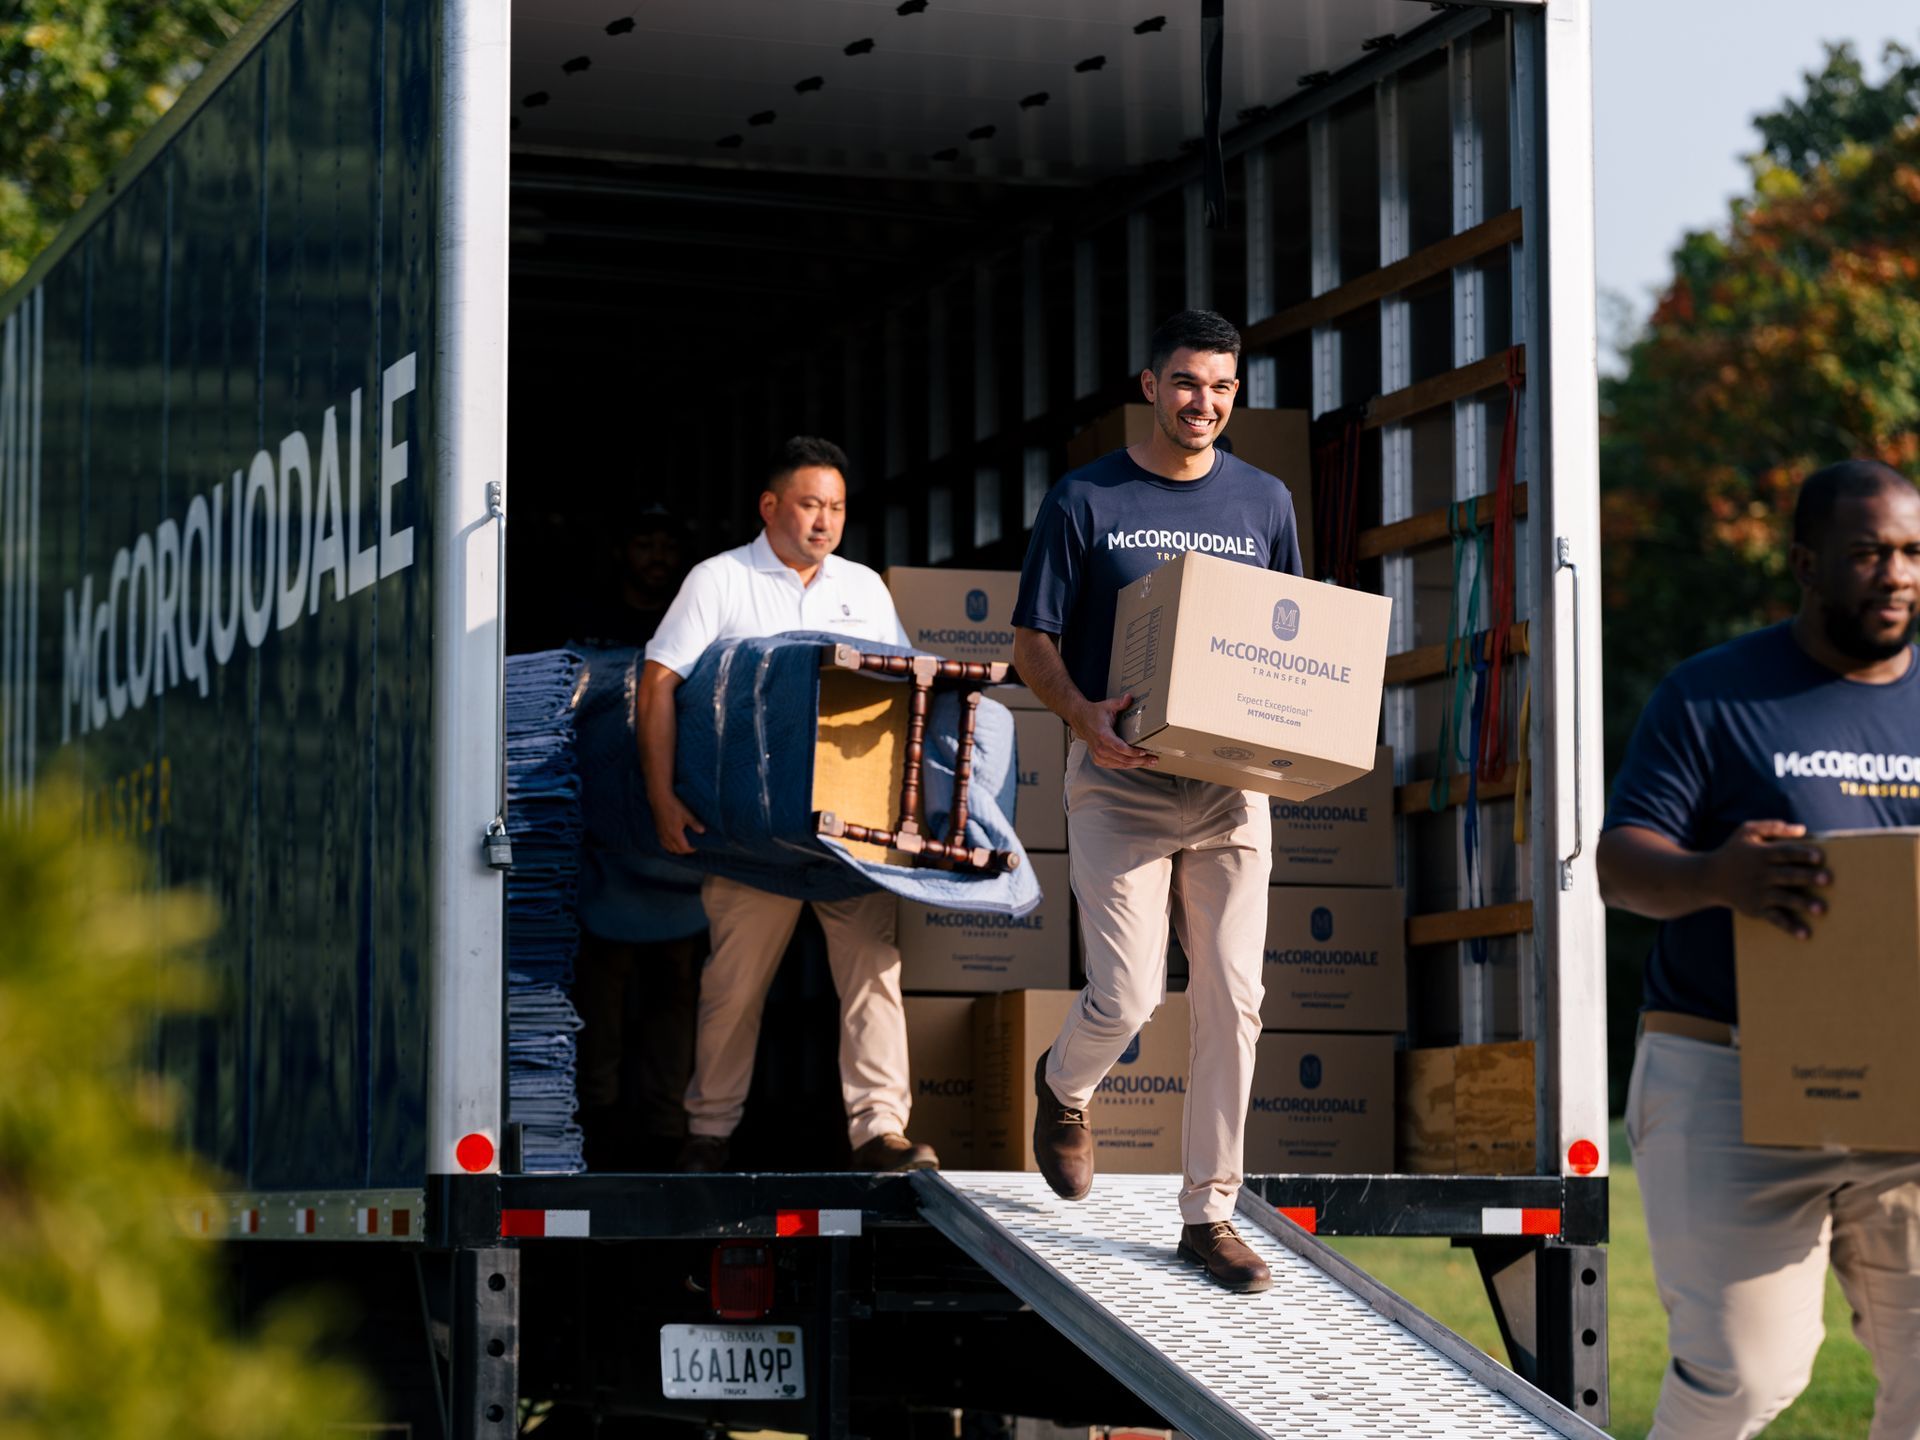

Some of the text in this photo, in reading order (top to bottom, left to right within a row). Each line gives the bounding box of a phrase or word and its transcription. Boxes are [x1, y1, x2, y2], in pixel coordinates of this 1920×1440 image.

[62, 352, 417, 744] McCORQUODALE
[1107, 529, 1256, 556] McCORQUODALE
[1156, 552, 1180, 561] TRA
[1210, 636, 1352, 684] McCORQUODALE
[1252, 667, 1307, 686] TRANSFER
[1237, 693, 1264, 706] Expect
[1247, 708, 1301, 727] MTMOVES.com
[1271, 804, 1368, 822] CORQUODALE
[1265, 950, 1379, 967] McCORQUODALE
[1094, 1076, 1186, 1094] RQUODAL
[1252, 1098, 1367, 1114] McCORQUODALE
[700, 1332, 765, 1343] ALABAMA
[672, 1347, 792, 1383] 16A1A9P
